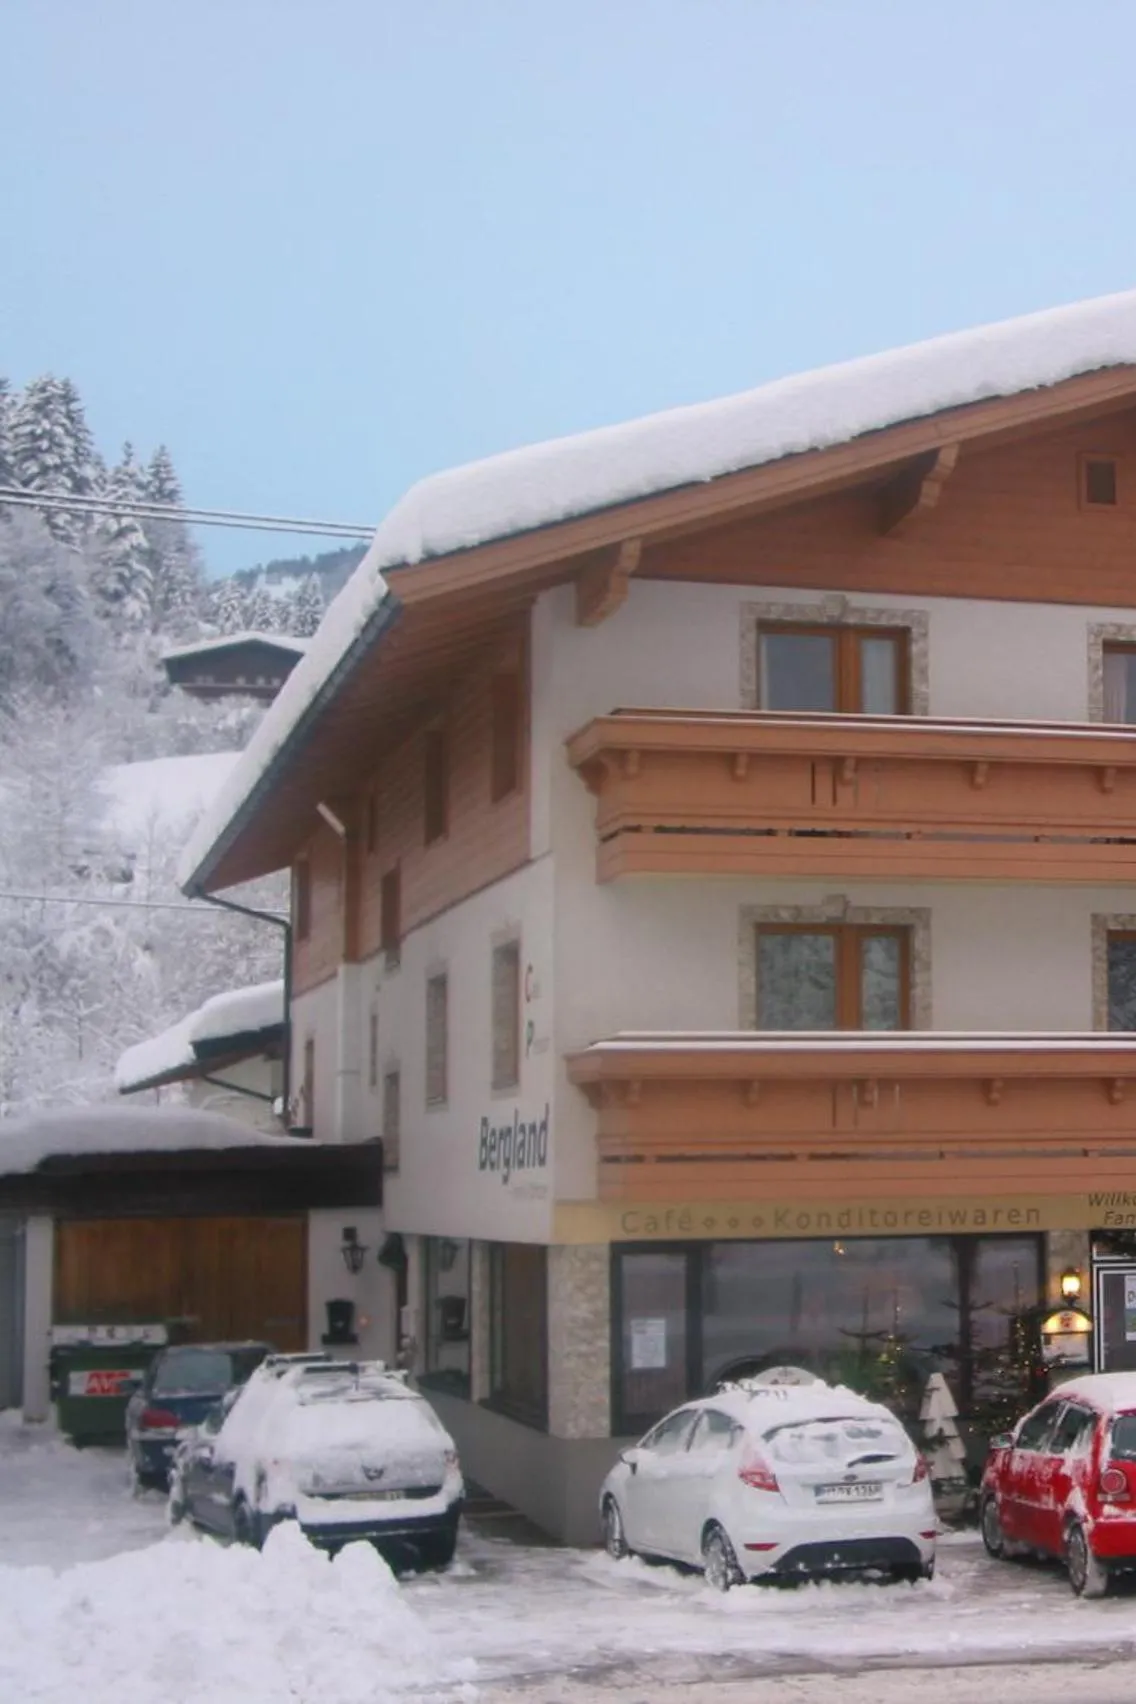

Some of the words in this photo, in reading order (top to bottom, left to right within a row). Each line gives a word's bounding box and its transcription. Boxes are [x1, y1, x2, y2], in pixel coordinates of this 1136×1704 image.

[479, 1103, 549, 1185] Bergland
[621, 1206, 692, 1234] Café
[774, 1207, 1041, 1231] Konditoreiwaren
